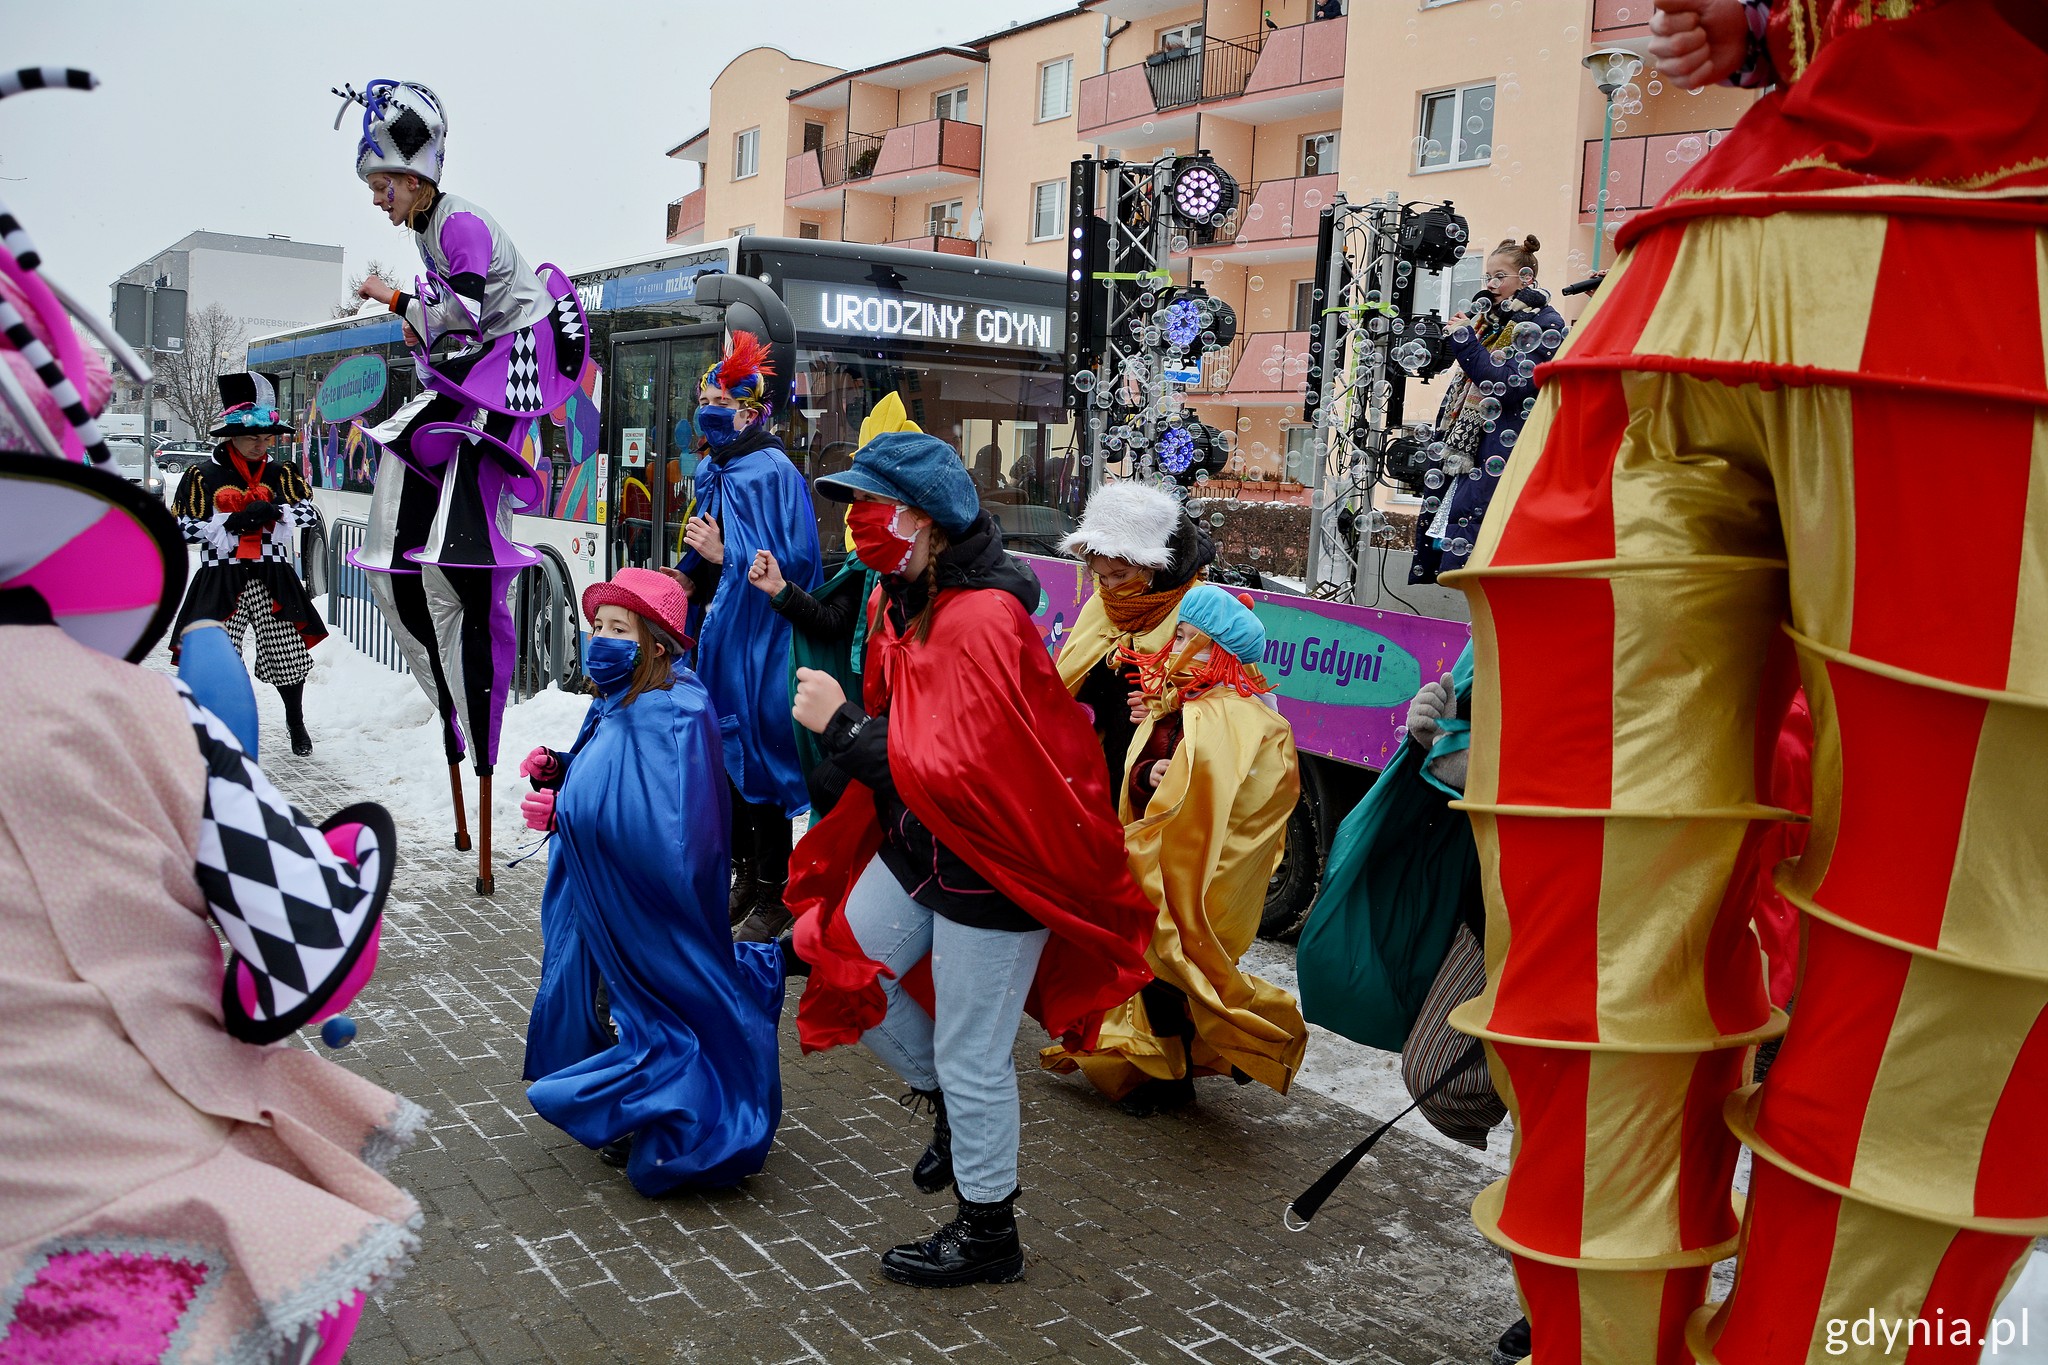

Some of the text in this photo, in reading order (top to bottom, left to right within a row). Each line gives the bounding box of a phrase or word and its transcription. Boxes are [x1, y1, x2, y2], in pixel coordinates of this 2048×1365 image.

[821, 292, 1052, 348] URODZINY GDYNI
[363, 363, 382, 393] Gdyni
[1301, 636, 1385, 687] Gdyni
